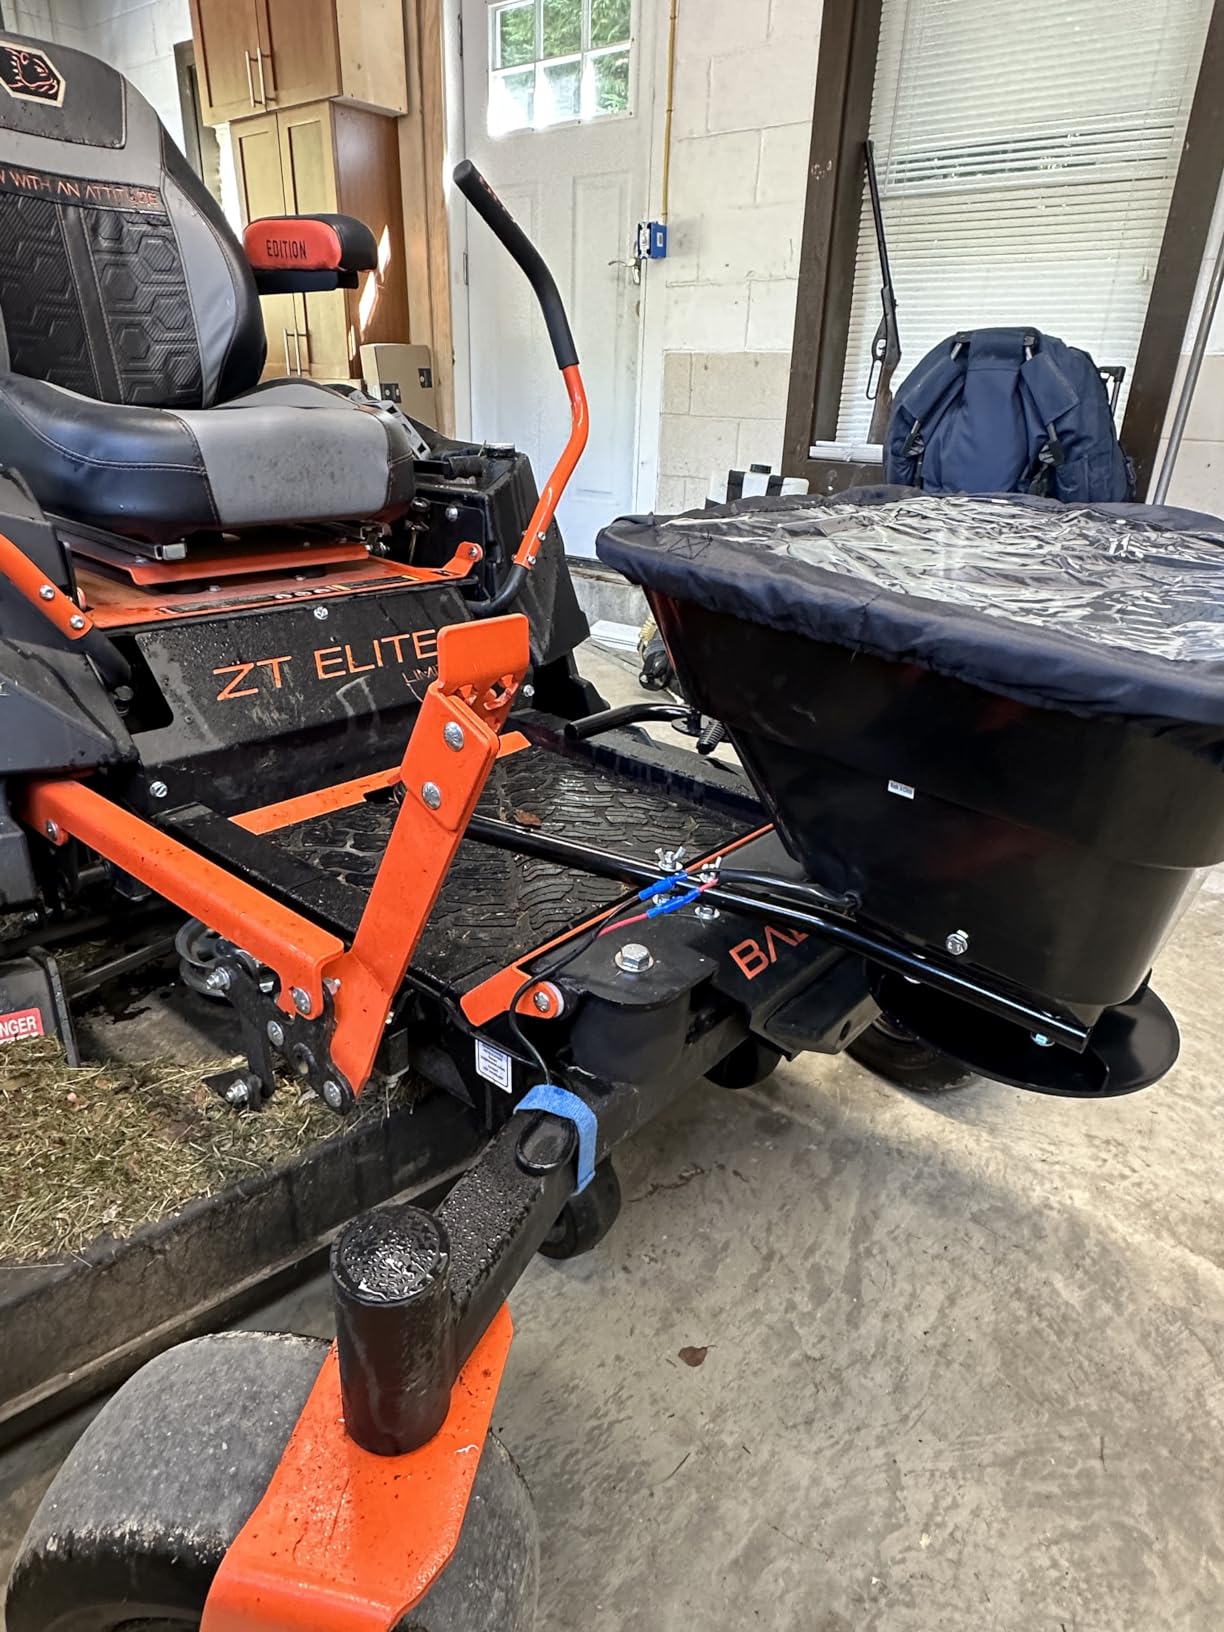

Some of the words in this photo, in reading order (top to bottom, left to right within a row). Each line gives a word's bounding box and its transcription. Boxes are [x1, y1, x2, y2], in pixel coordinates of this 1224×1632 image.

[8, 169, 52, 192] WITH
[57, 180, 81, 198] AN
[266, 239, 308, 259] EDITION
[212, 656, 292, 700] ZT
[314, 629, 438, 680] ELITE
[401, 664, 439, 683] LIMI
